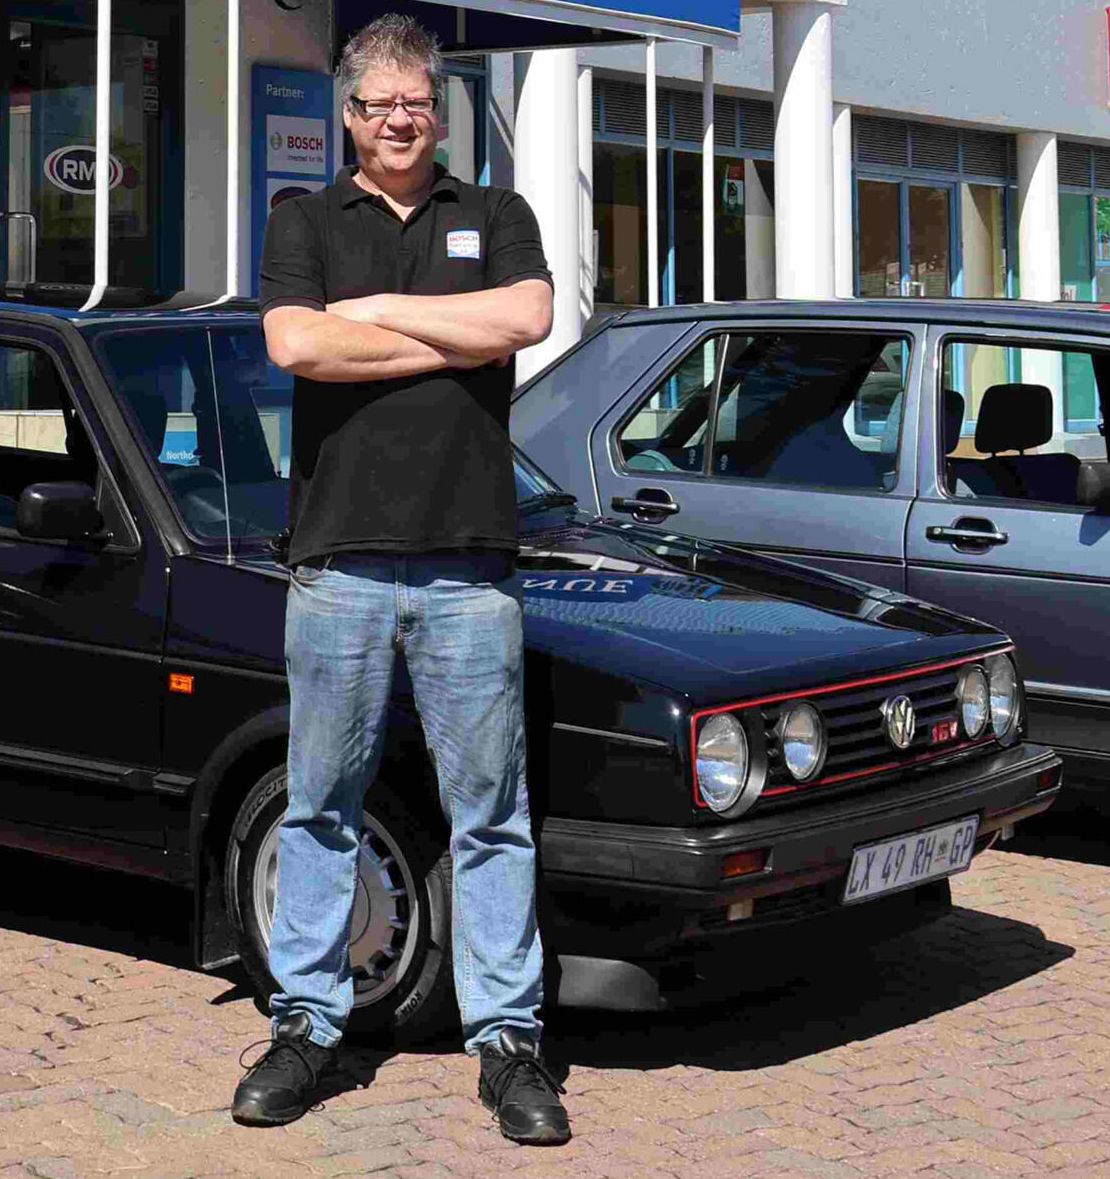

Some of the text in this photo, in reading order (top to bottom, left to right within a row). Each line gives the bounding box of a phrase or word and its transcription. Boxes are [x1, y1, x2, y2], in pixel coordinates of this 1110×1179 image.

[266, 83, 305, 99] Partner:
[287, 135, 323, 151] BOSCH
[62, 158, 97, 182] RM
[848, 824, 974, 894] LX 49 RH GP
